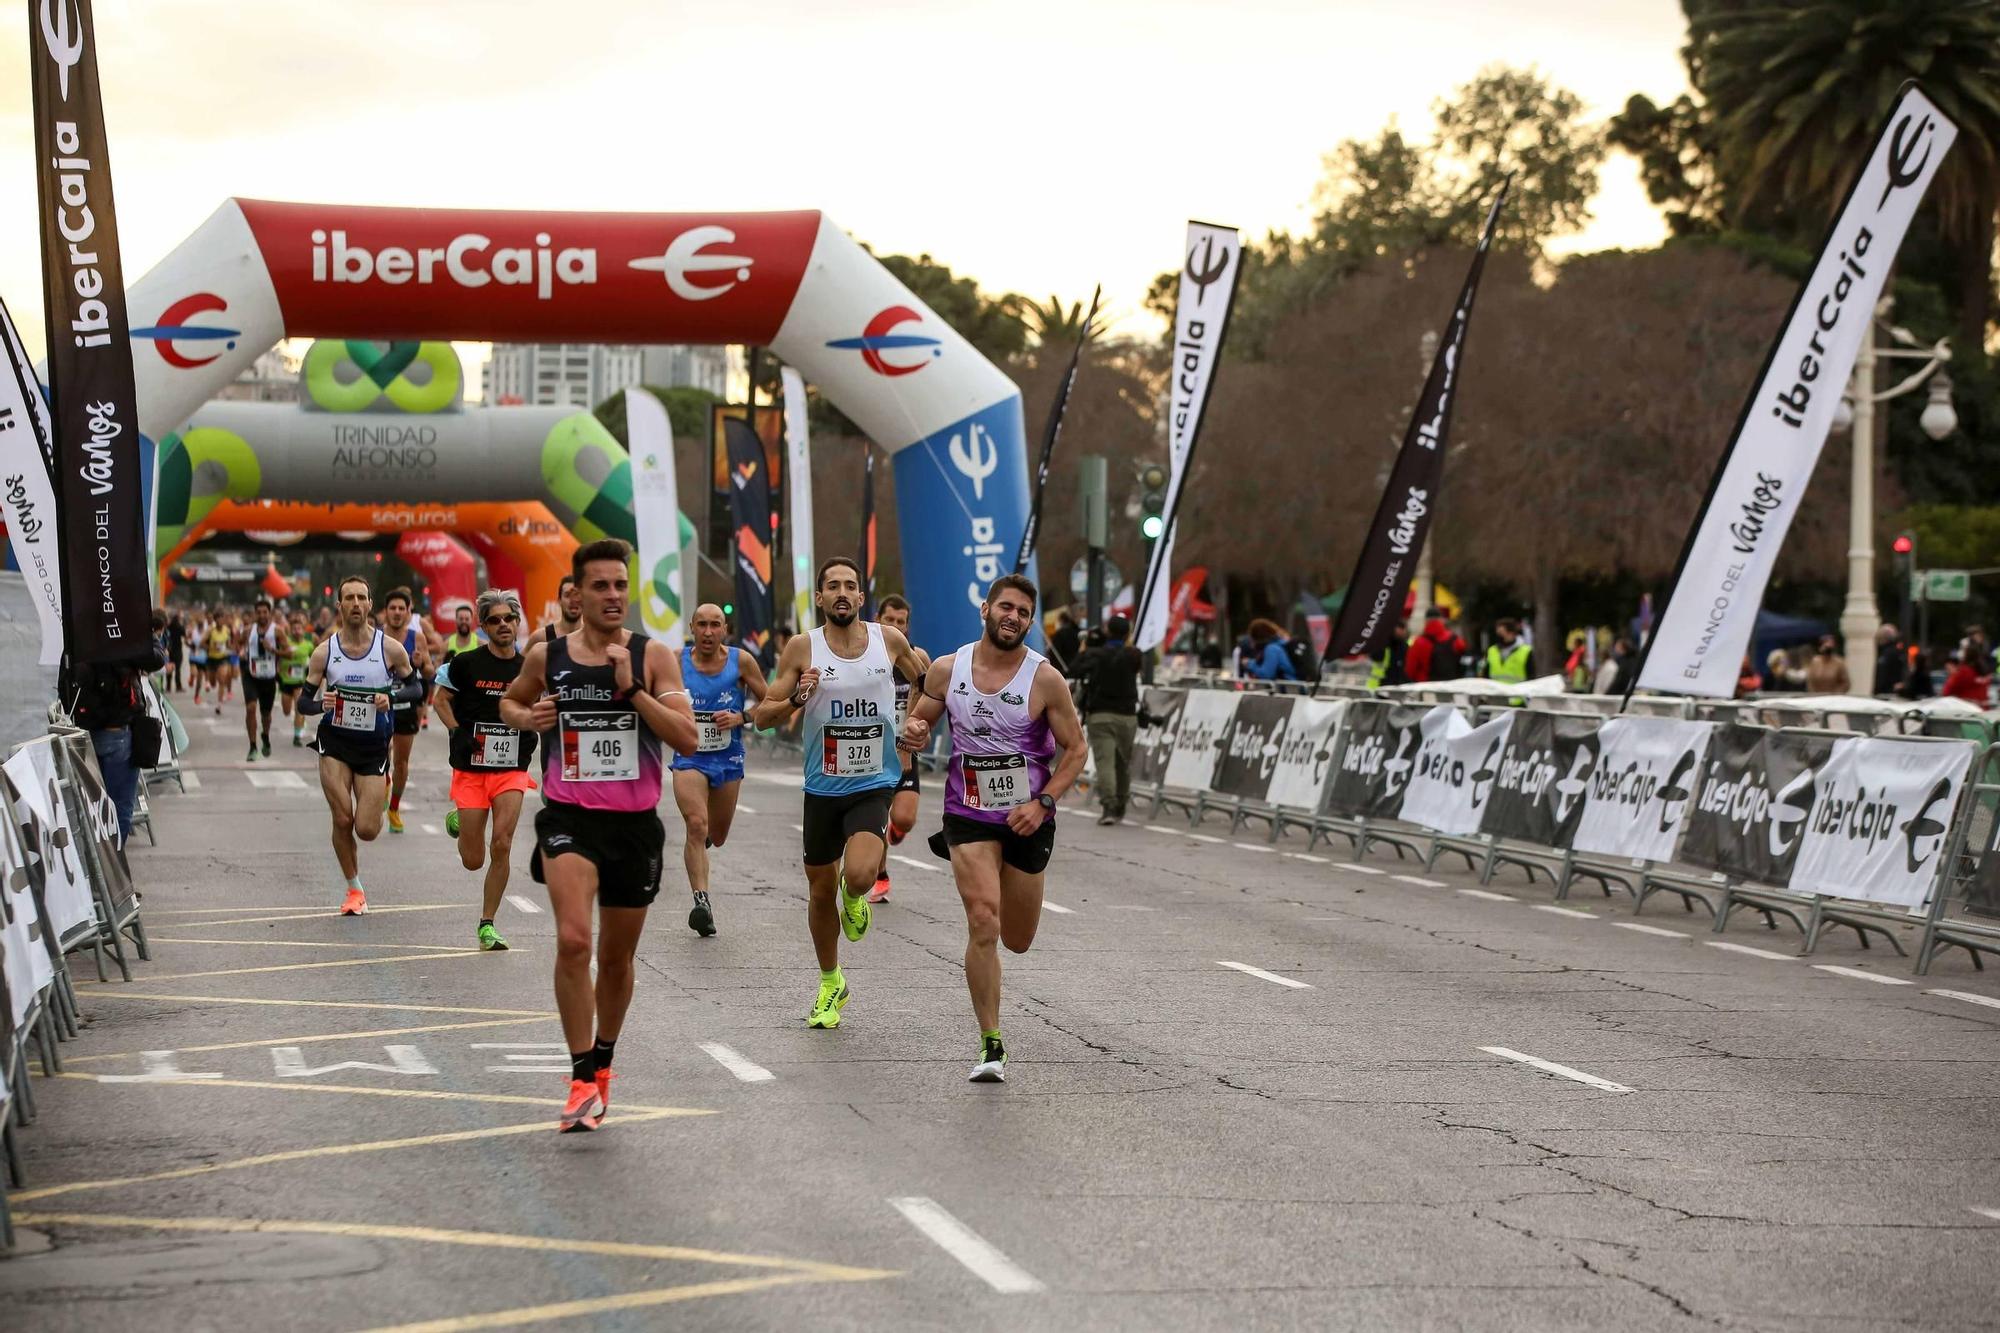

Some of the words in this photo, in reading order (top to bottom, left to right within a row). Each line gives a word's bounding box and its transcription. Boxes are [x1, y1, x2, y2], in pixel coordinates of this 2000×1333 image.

[52, 121, 112, 348] iberCaja
[311, 230, 598, 299] iberCaja
[1773, 225, 1875, 429] iberCaja
[332, 425, 437, 446] TRINIDAD
[332, 447, 438, 469] ALFONSO
[96, 502, 110, 541] DEL
[372, 508, 457, 528] seguros
[98, 546, 117, 613] BANCO
[1361, 588, 1390, 639] BANCO
[1382, 559, 1402, 587] DEL
[107, 617, 122, 639] EL
[1683, 661, 1702, 680] EL
[1695, 596, 1728, 655] BANCO
[1722, 561, 1746, 592] DEL
[571, 684, 612, 700] millas
[350, 706, 367, 718] 234
[830, 698, 879, 719] Delta
[480, 725, 506, 735] iberCaja
[568, 718, 608, 728] iberCaja
[830, 728, 862, 738] iberCaja
[493, 740, 510, 753] 442
[591, 739, 622, 758] 406
[848, 744, 871, 760] 378
[968, 758, 1001, 768] iberCaja
[988, 775, 1014, 791] 448
[1812, 780, 1898, 856] iberCaja
